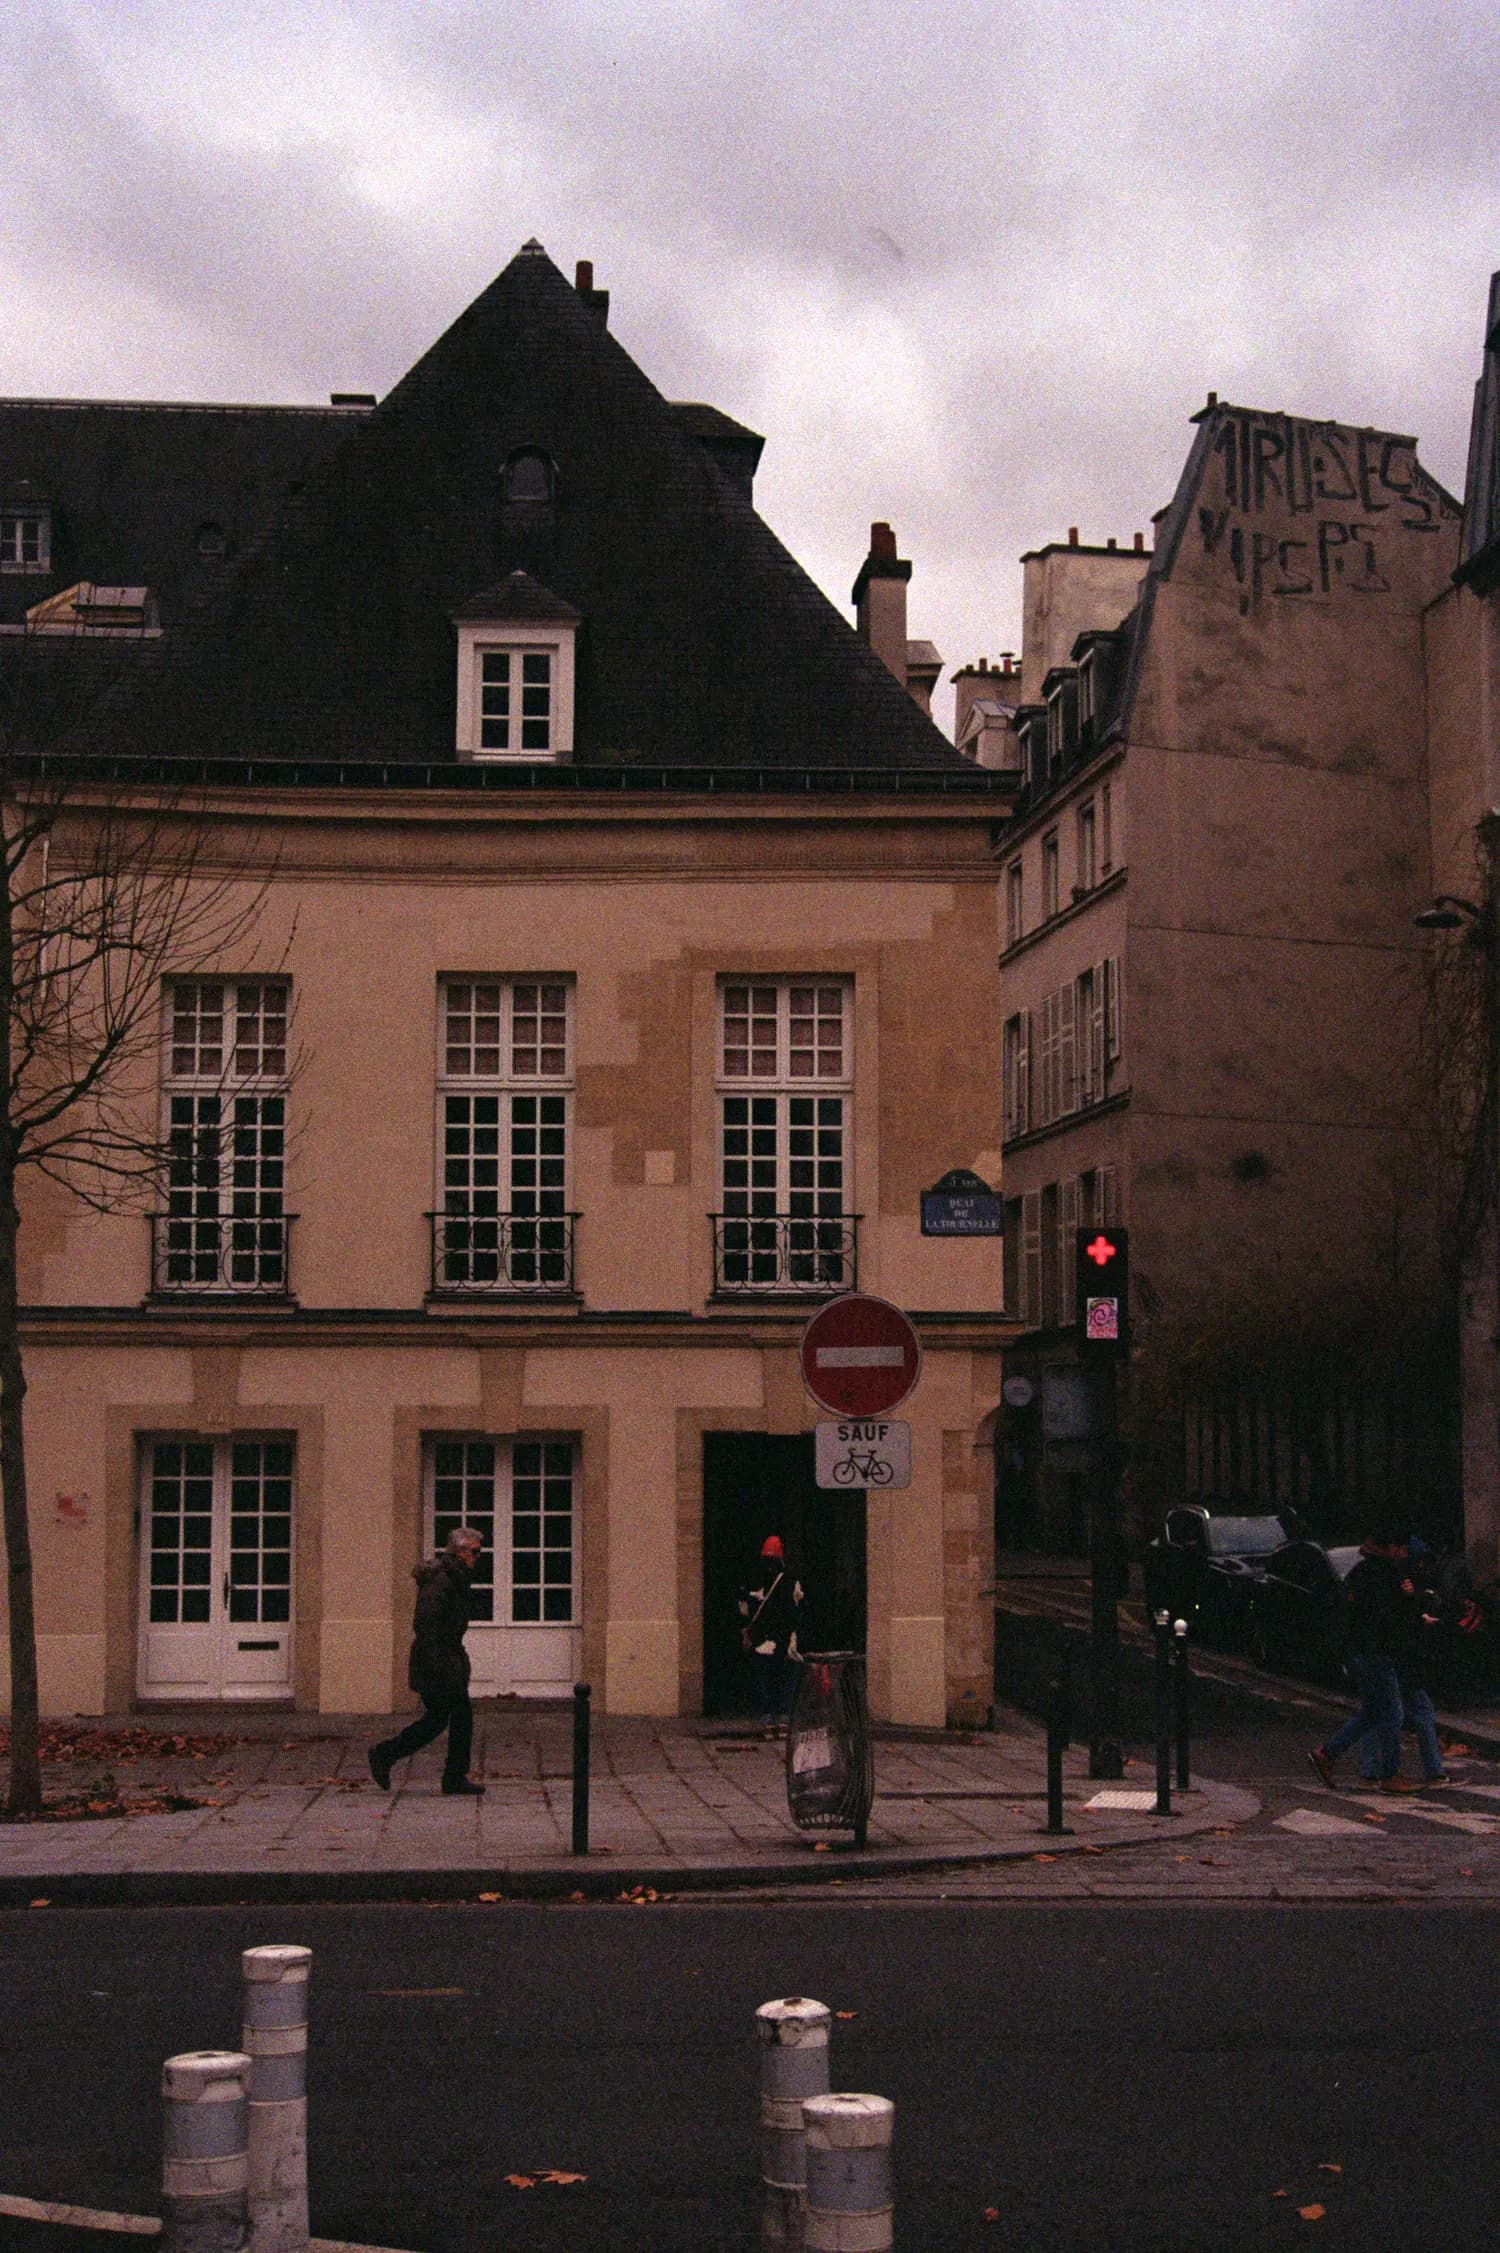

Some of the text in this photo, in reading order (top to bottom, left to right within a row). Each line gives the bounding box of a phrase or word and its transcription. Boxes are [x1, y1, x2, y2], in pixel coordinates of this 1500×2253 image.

[948, 1198, 975, 1209] QUAI
[953, 1209, 970, 1218] DE
[925, 1219, 1000, 1229] LA TOURNELLE
[837, 1425, 889, 1442] SAUF
